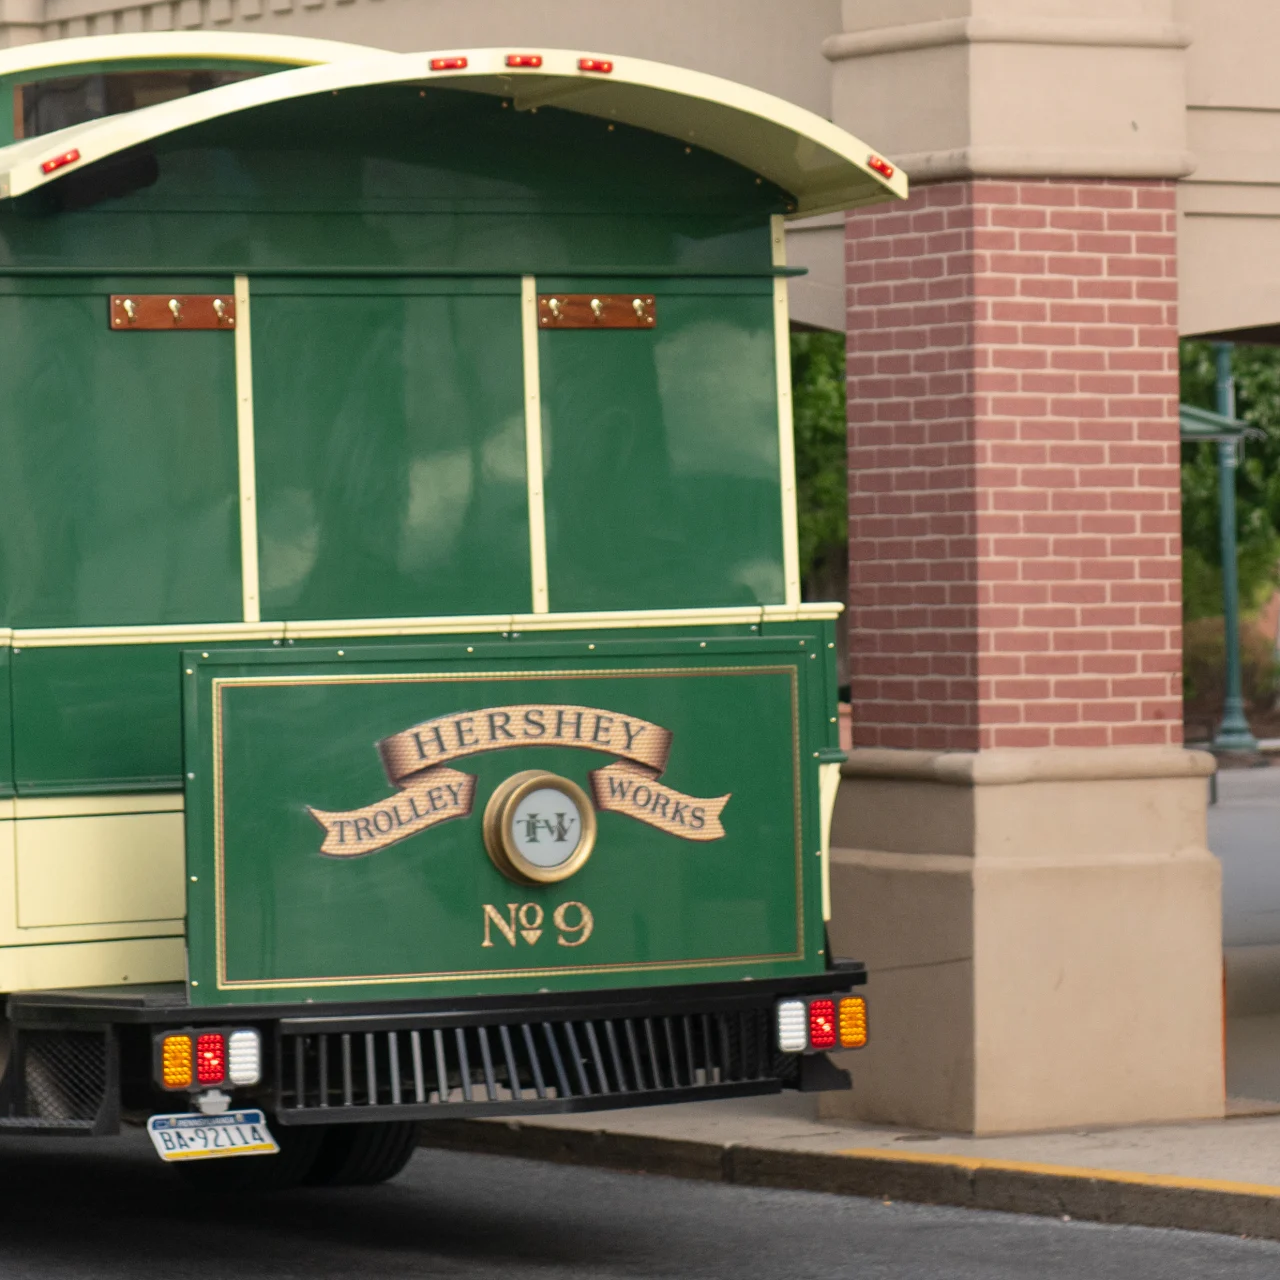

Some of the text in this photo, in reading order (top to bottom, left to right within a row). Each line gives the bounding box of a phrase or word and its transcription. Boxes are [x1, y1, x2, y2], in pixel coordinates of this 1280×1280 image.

[411, 708, 646, 760] HERSHEY
[333, 775, 706, 845] TROLLEY WORKS
[553, 900, 595, 948] 9
